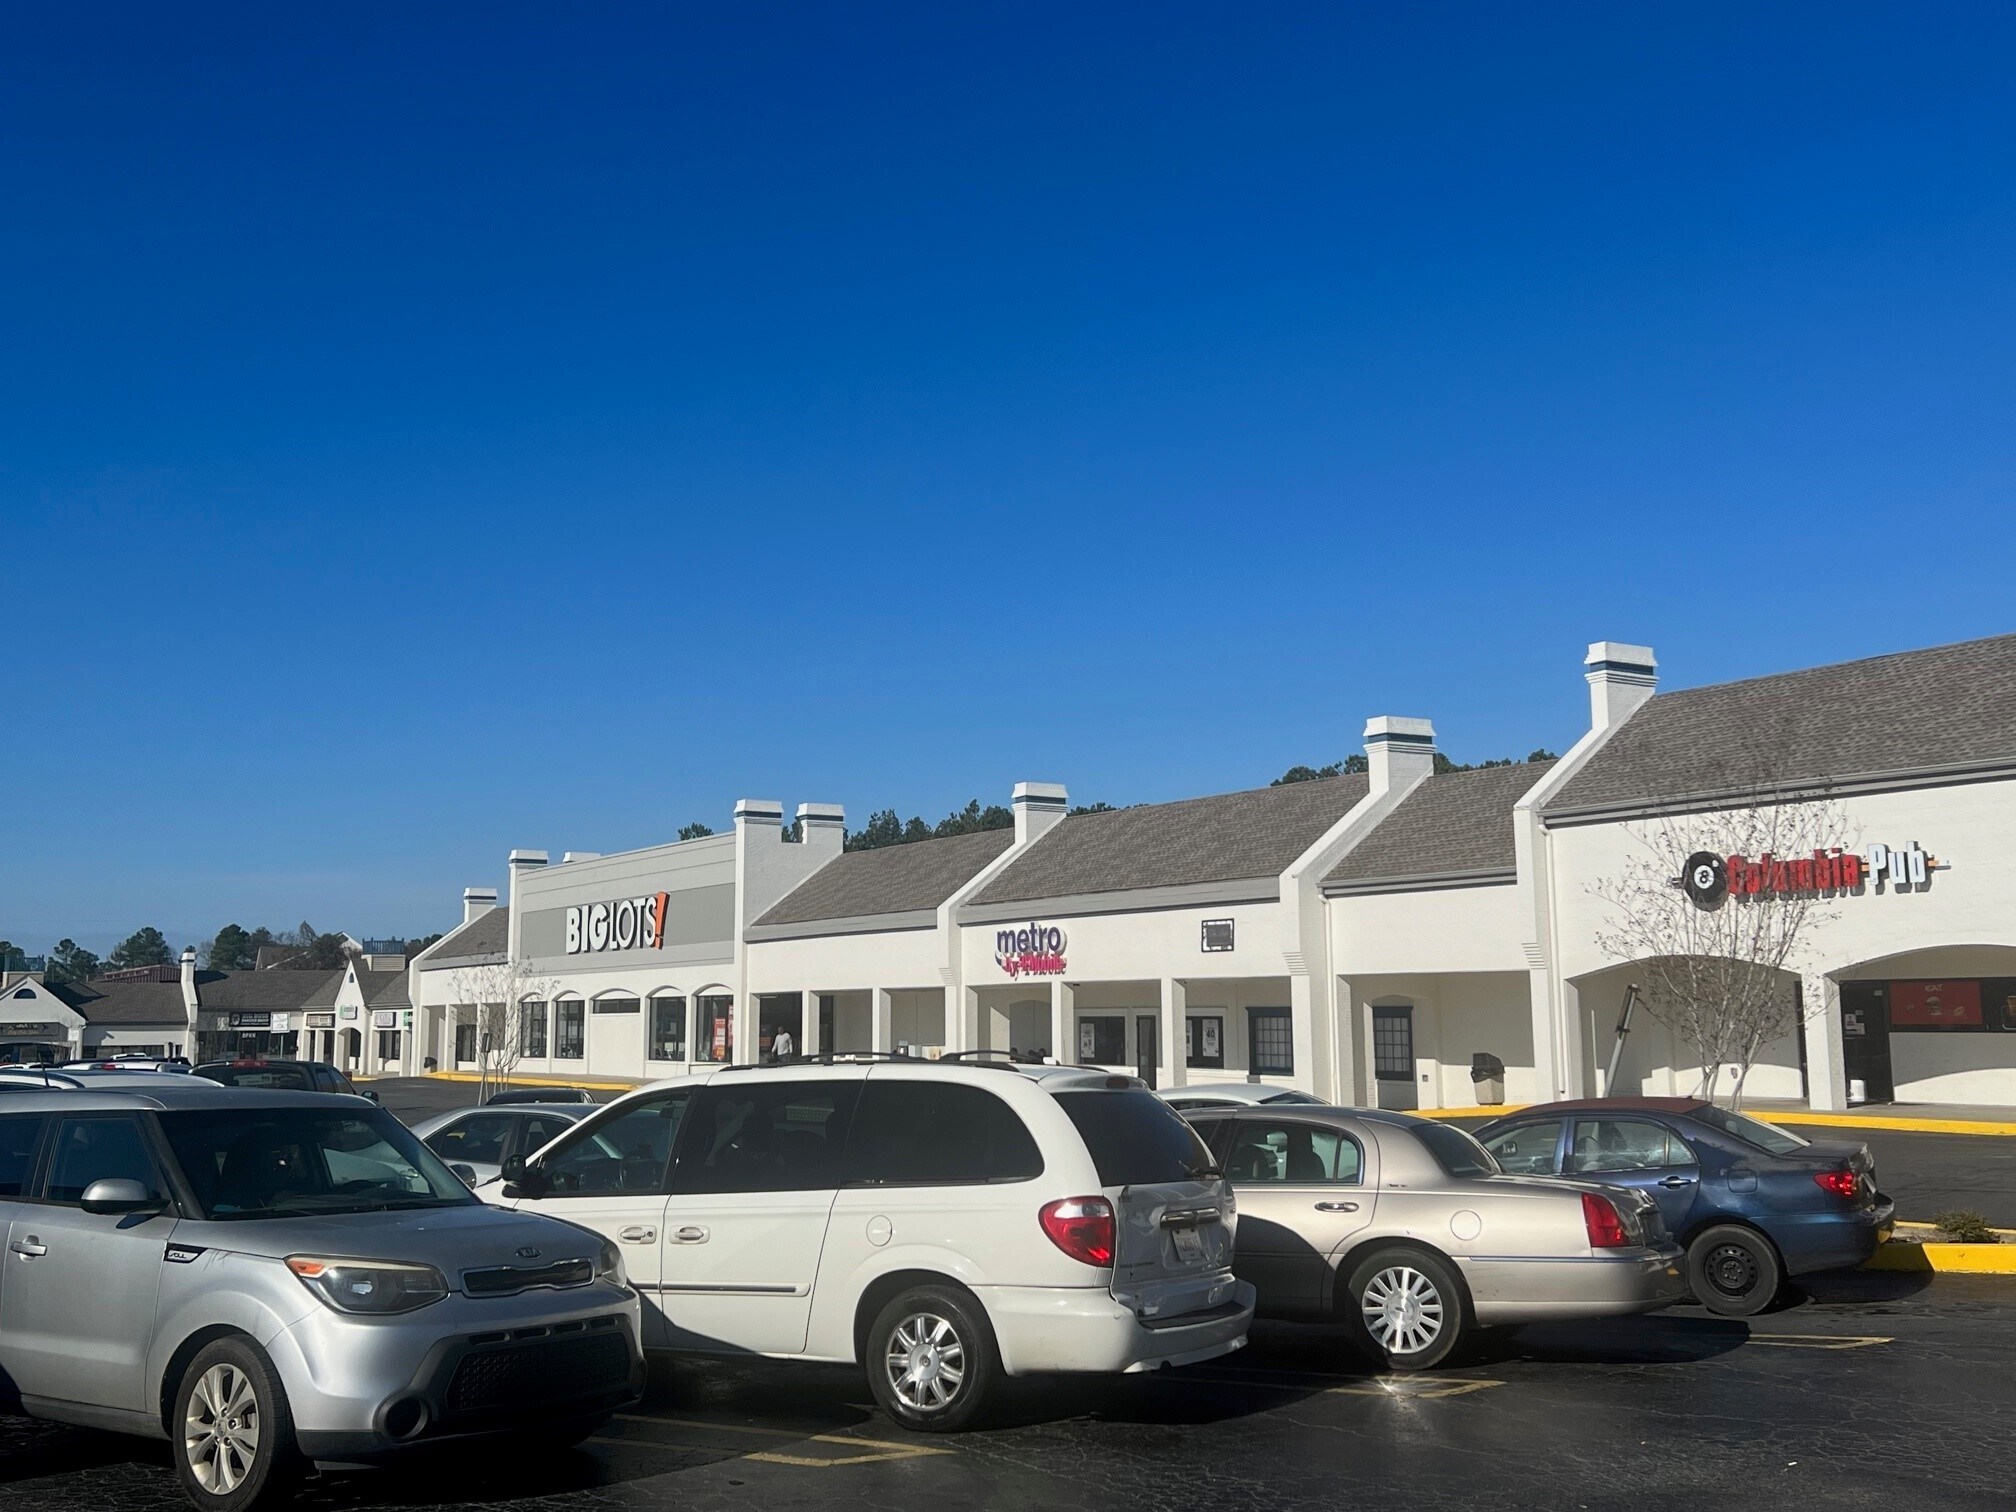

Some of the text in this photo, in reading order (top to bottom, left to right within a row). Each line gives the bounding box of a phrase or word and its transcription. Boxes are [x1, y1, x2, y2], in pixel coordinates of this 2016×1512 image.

[1867, 841, 1926, 886] Pub
[997, 922, 1061, 952] metro
[1925, 984, 1943, 992] EAT
